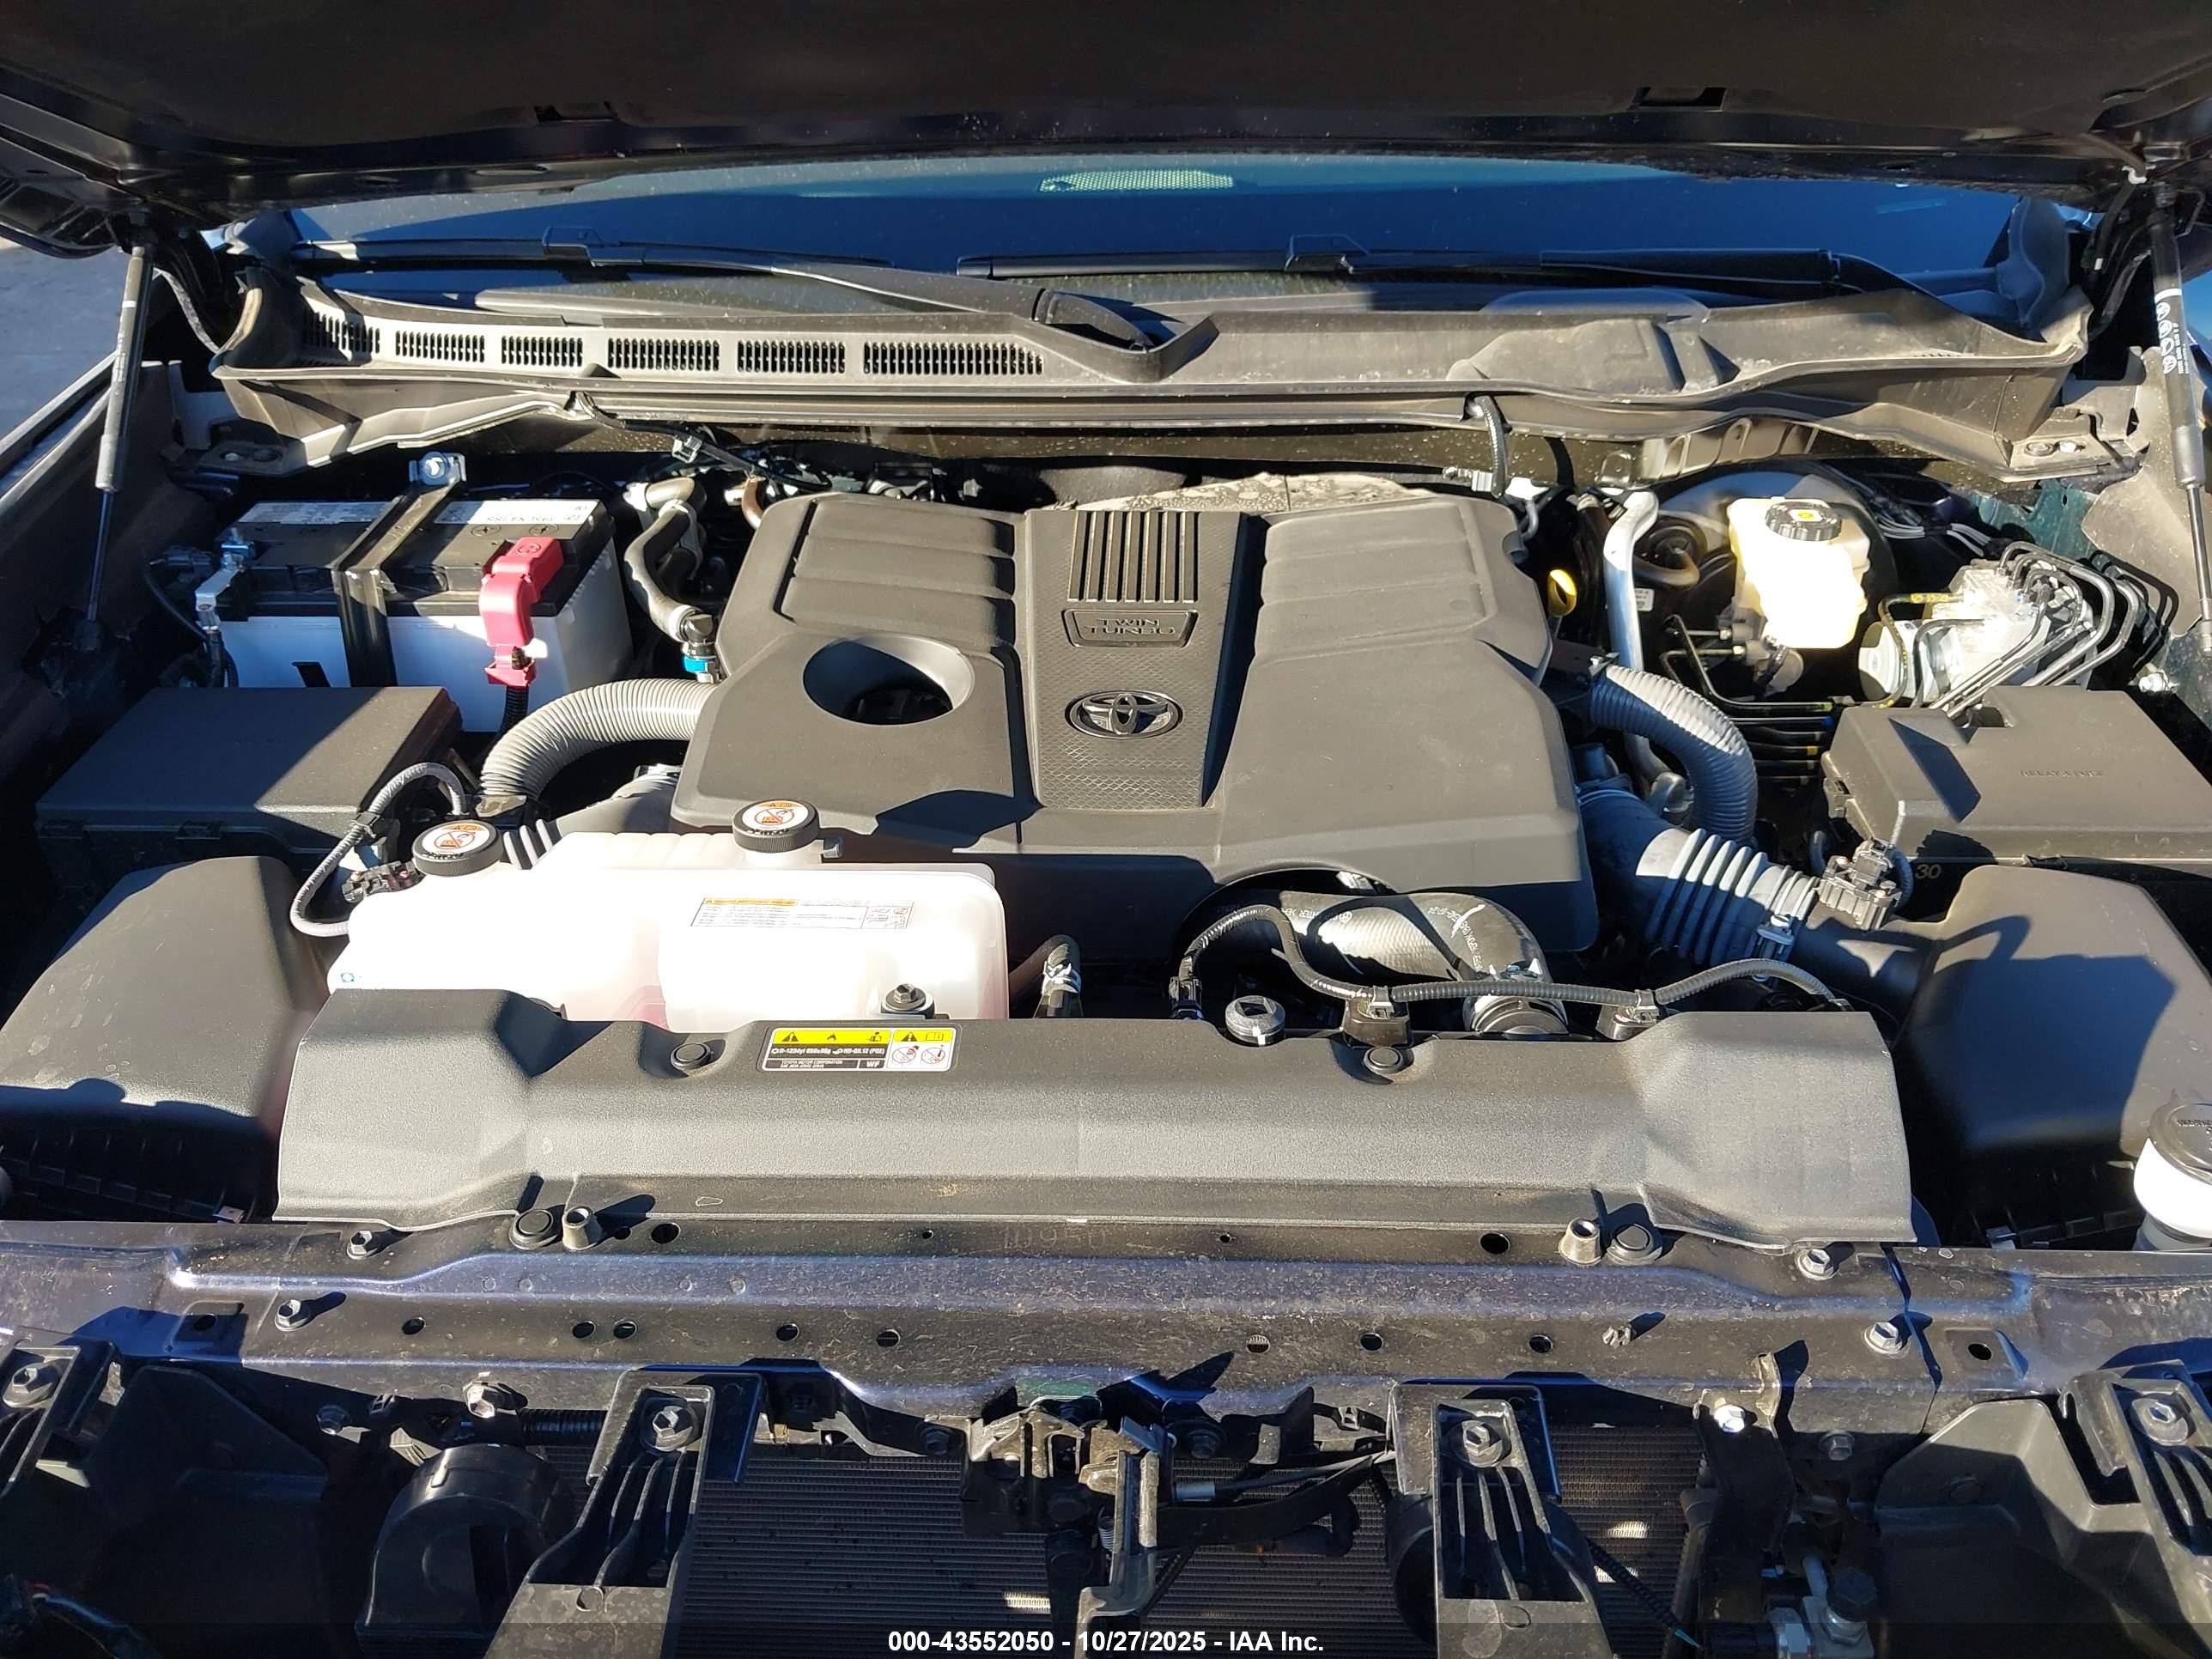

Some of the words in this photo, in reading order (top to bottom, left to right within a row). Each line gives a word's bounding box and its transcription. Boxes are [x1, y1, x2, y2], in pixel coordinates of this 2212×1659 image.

[1096, 617, 1160, 627] TWIN
[1084, 625, 1176, 635] TURBO
[1915, 864, 1942, 879] 30
